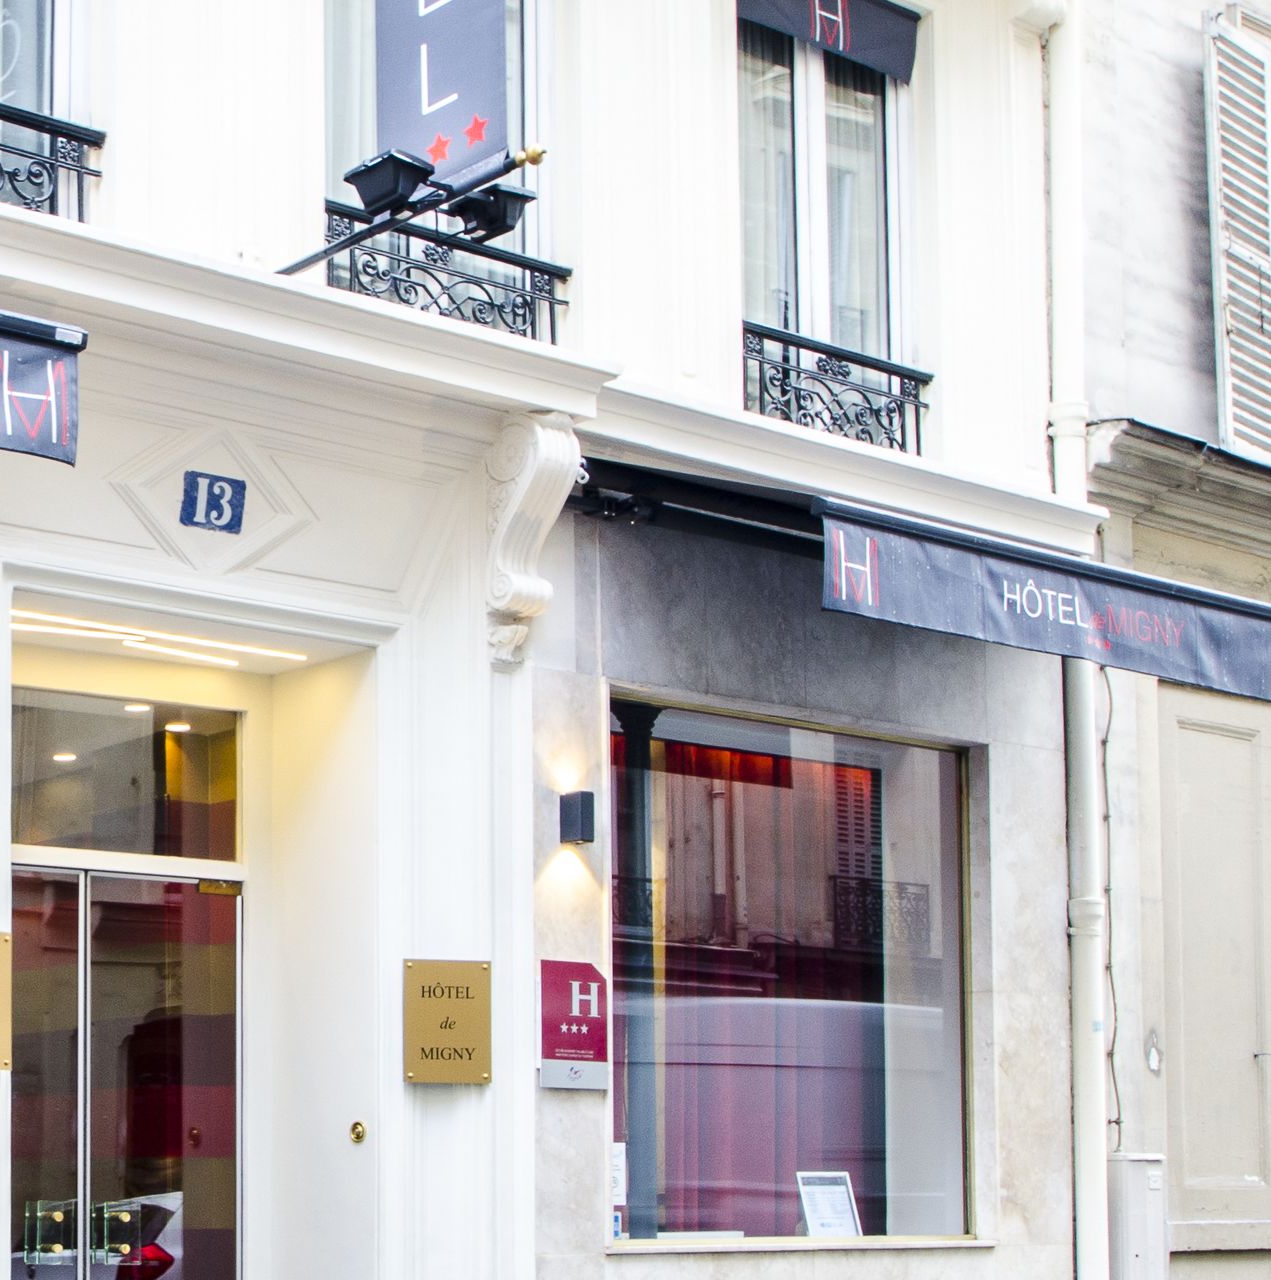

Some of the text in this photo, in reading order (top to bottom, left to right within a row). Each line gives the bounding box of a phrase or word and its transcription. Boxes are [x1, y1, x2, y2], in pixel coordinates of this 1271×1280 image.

[193, 477, 233, 526] 13
[1003, 579, 1093, 630] HÔTEL
[1106, 603, 1185, 649] MIGNY
[420, 982, 475, 1000] HÔTEL
[569, 980, 601, 1018] H
[439, 1016, 456, 1030] de
[420, 1047, 476, 1061] MIGNY
